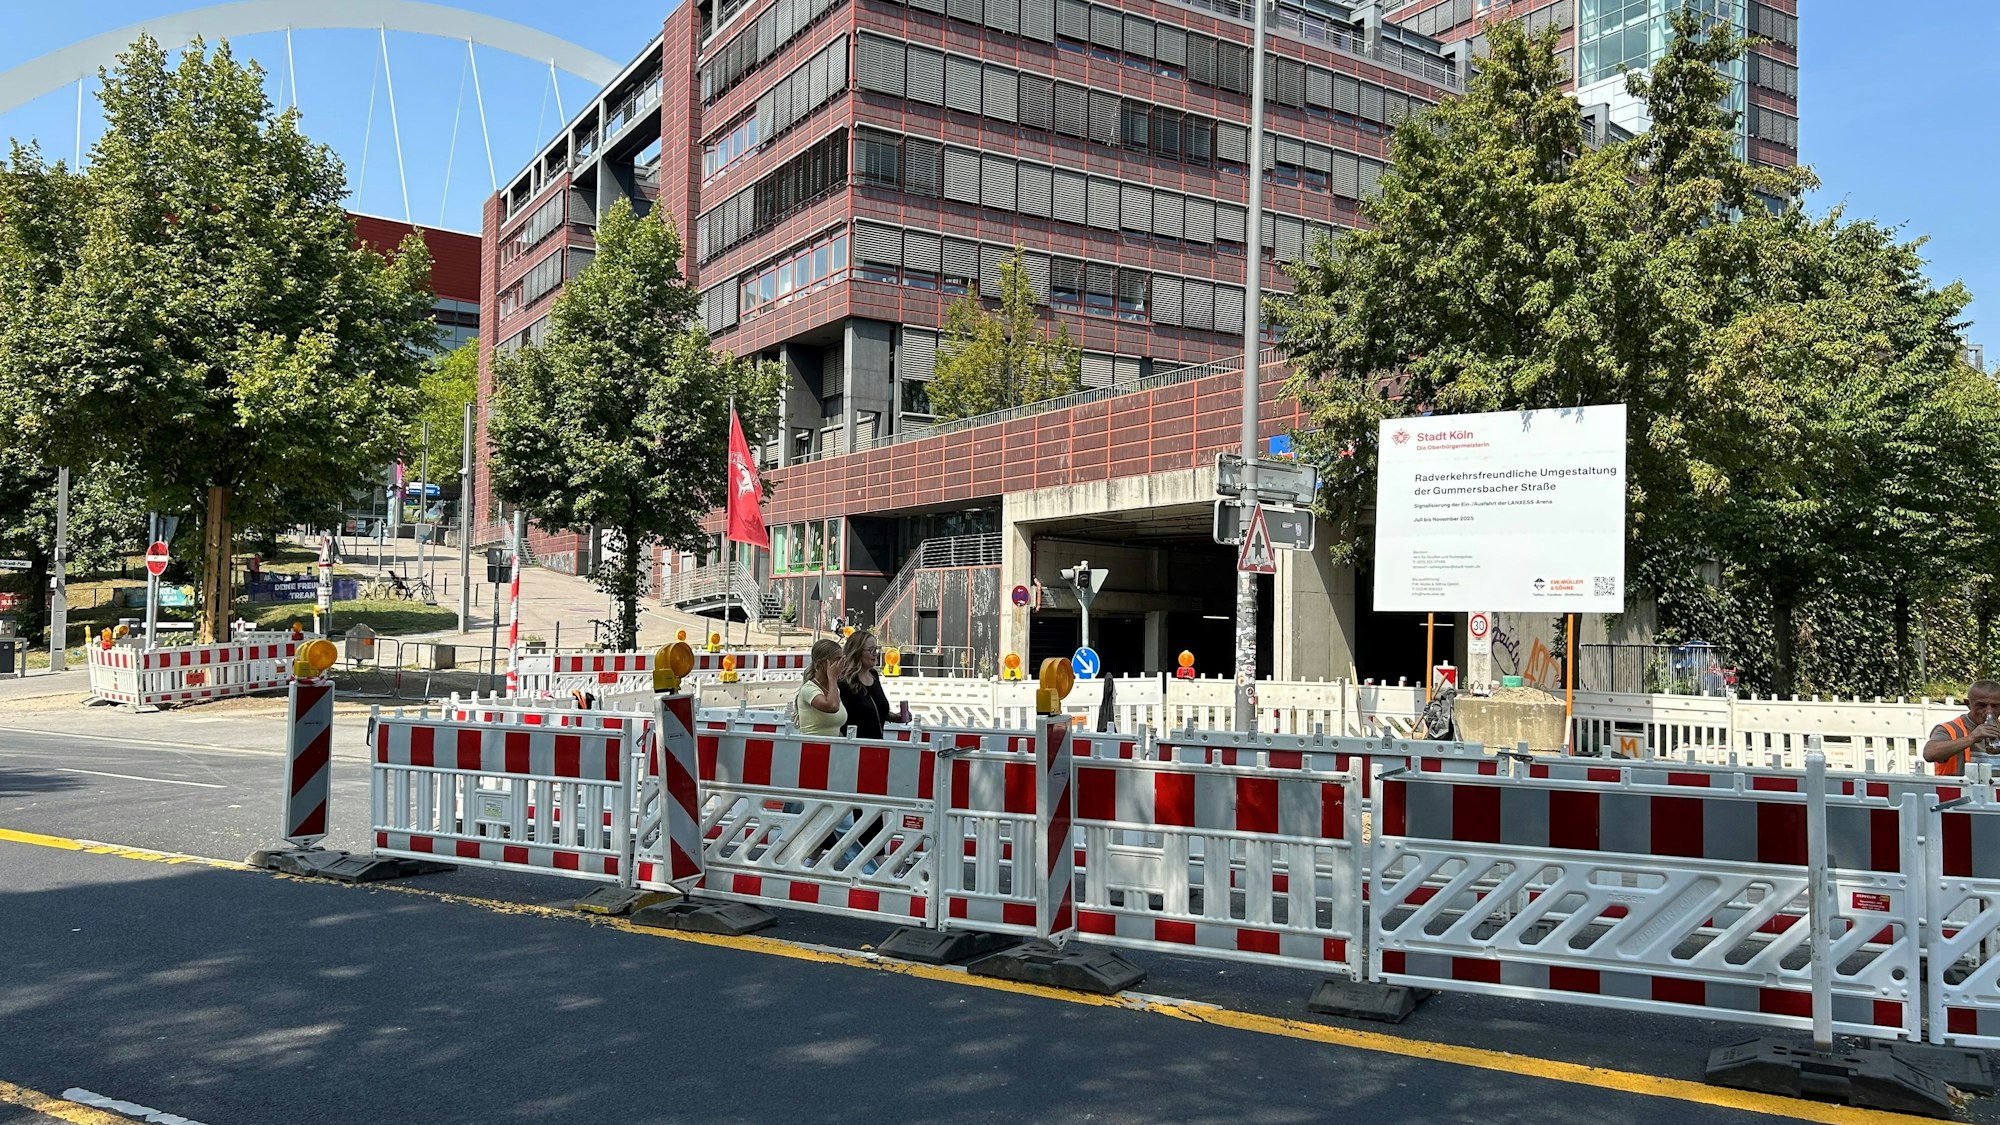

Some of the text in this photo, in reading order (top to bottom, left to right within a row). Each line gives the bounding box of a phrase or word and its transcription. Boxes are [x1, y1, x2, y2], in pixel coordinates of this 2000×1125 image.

[1417, 430, 1474, 442] Stadt Köln
[1427, 442, 1490, 450] Oberbürgermeisterin
[1414, 466, 1617, 482] Radverkehrsfreundliche Umgestaltung
[1414, 482, 1557, 496] der Gummersbacher Straße
[274, 582, 296, 591] DEINE
[1473, 620, 1485, 631] 30
[1620, 736, 1639, 760] M
